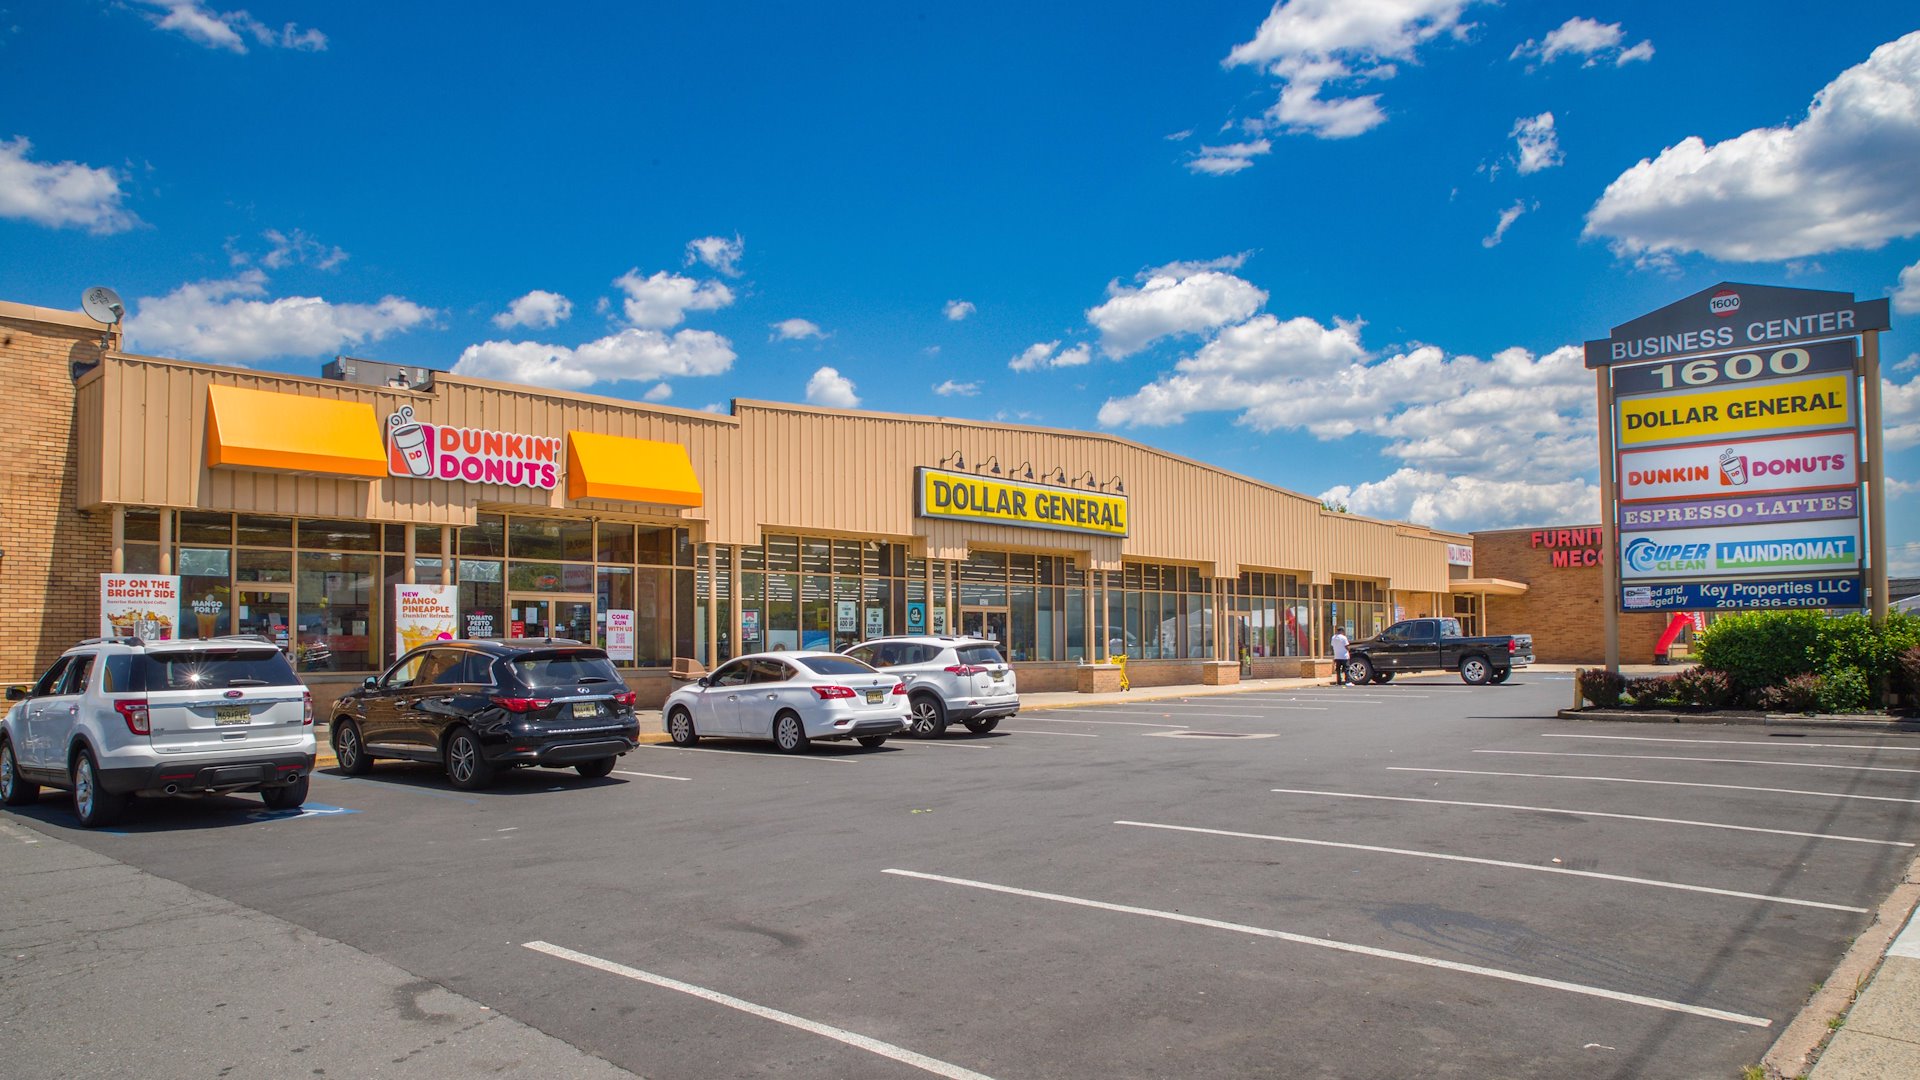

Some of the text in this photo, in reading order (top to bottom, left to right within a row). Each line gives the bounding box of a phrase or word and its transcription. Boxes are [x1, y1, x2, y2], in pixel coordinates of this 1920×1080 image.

[1711, 298, 1740, 309] 1600
[1612, 309, 1855, 360] BUSINESS CENTER
[1651, 348, 1810, 389] 1600
[1626, 391, 1843, 430] DOLLAR GENERAL
[440, 427, 561, 462] DUNKIN'
[409, 450, 422, 460] DD
[440, 454, 556, 489] DONUTS
[1628, 465, 1709, 486] DUNKIN
[1752, 454, 1845, 477] DONUTS
[933, 480, 1124, 528] DOLLAR GENERAL
[1531, 527, 1603, 549] FURNIT
[1640, 543, 1711, 562] SUPER
[1723, 540, 1847, 564] LAUNDROMAT
[1657, 560, 1706, 571] CLEAN
[107, 579, 170, 589] SIP ON THE
[1665, 585, 1684, 596] and
[1700, 580, 1850, 599] Key Properties LLC
[107, 589, 175, 599] BRIGHT SIDE
[1676, 595, 1689, 605] by
[1716, 597, 1828, 608] 201-836-6100
[191, 600, 223, 608] MANGO
